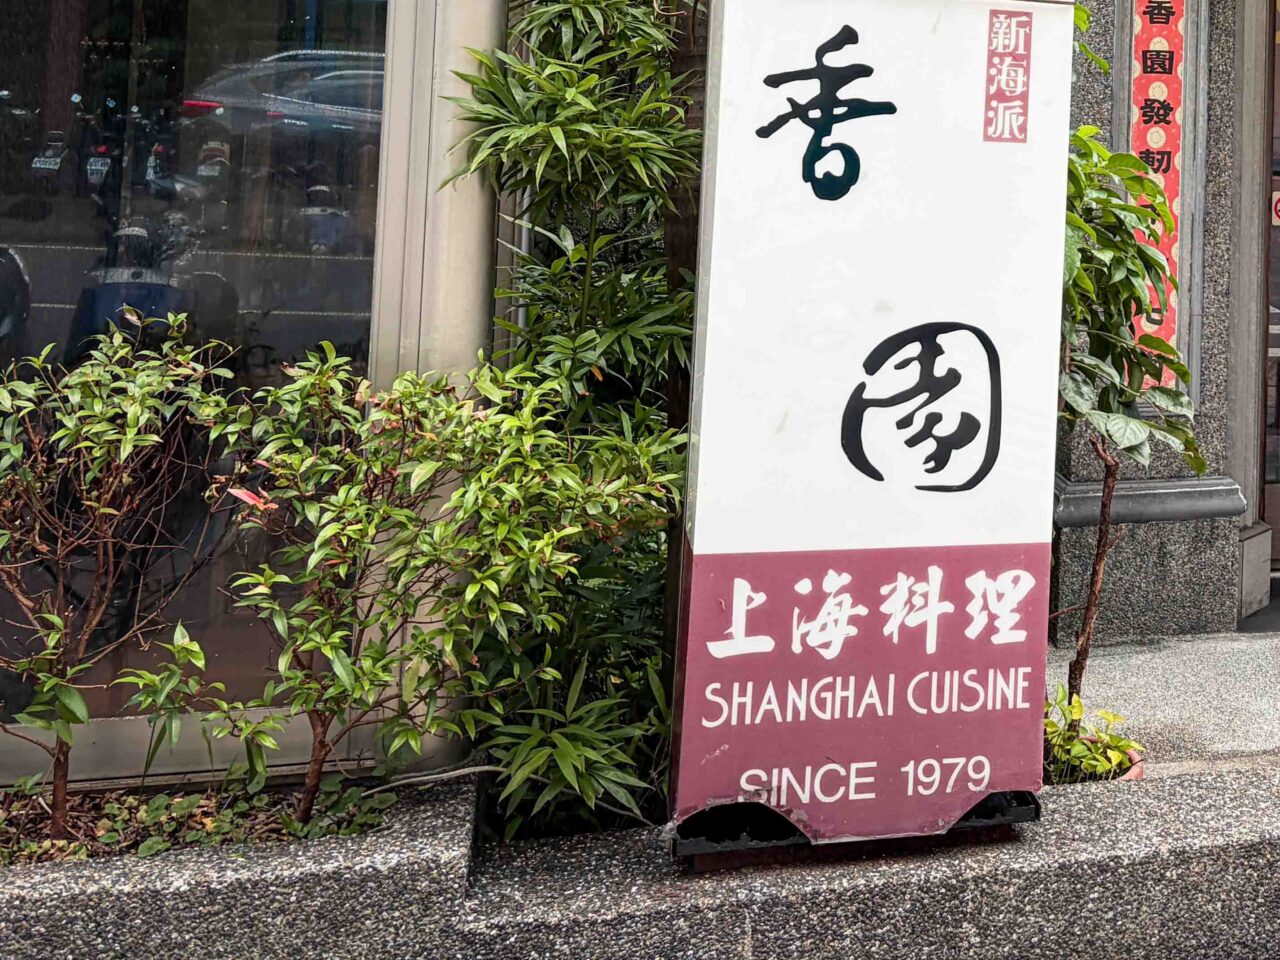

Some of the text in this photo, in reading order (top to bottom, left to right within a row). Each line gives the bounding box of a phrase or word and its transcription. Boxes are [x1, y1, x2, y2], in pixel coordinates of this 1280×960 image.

[984, 12, 1031, 141] 新海派
[705, 564, 1037, 660] 上海料理
[701, 666, 1033, 729] SHANGHAI CUISINE
[738, 754, 992, 807] SINCE 1979
